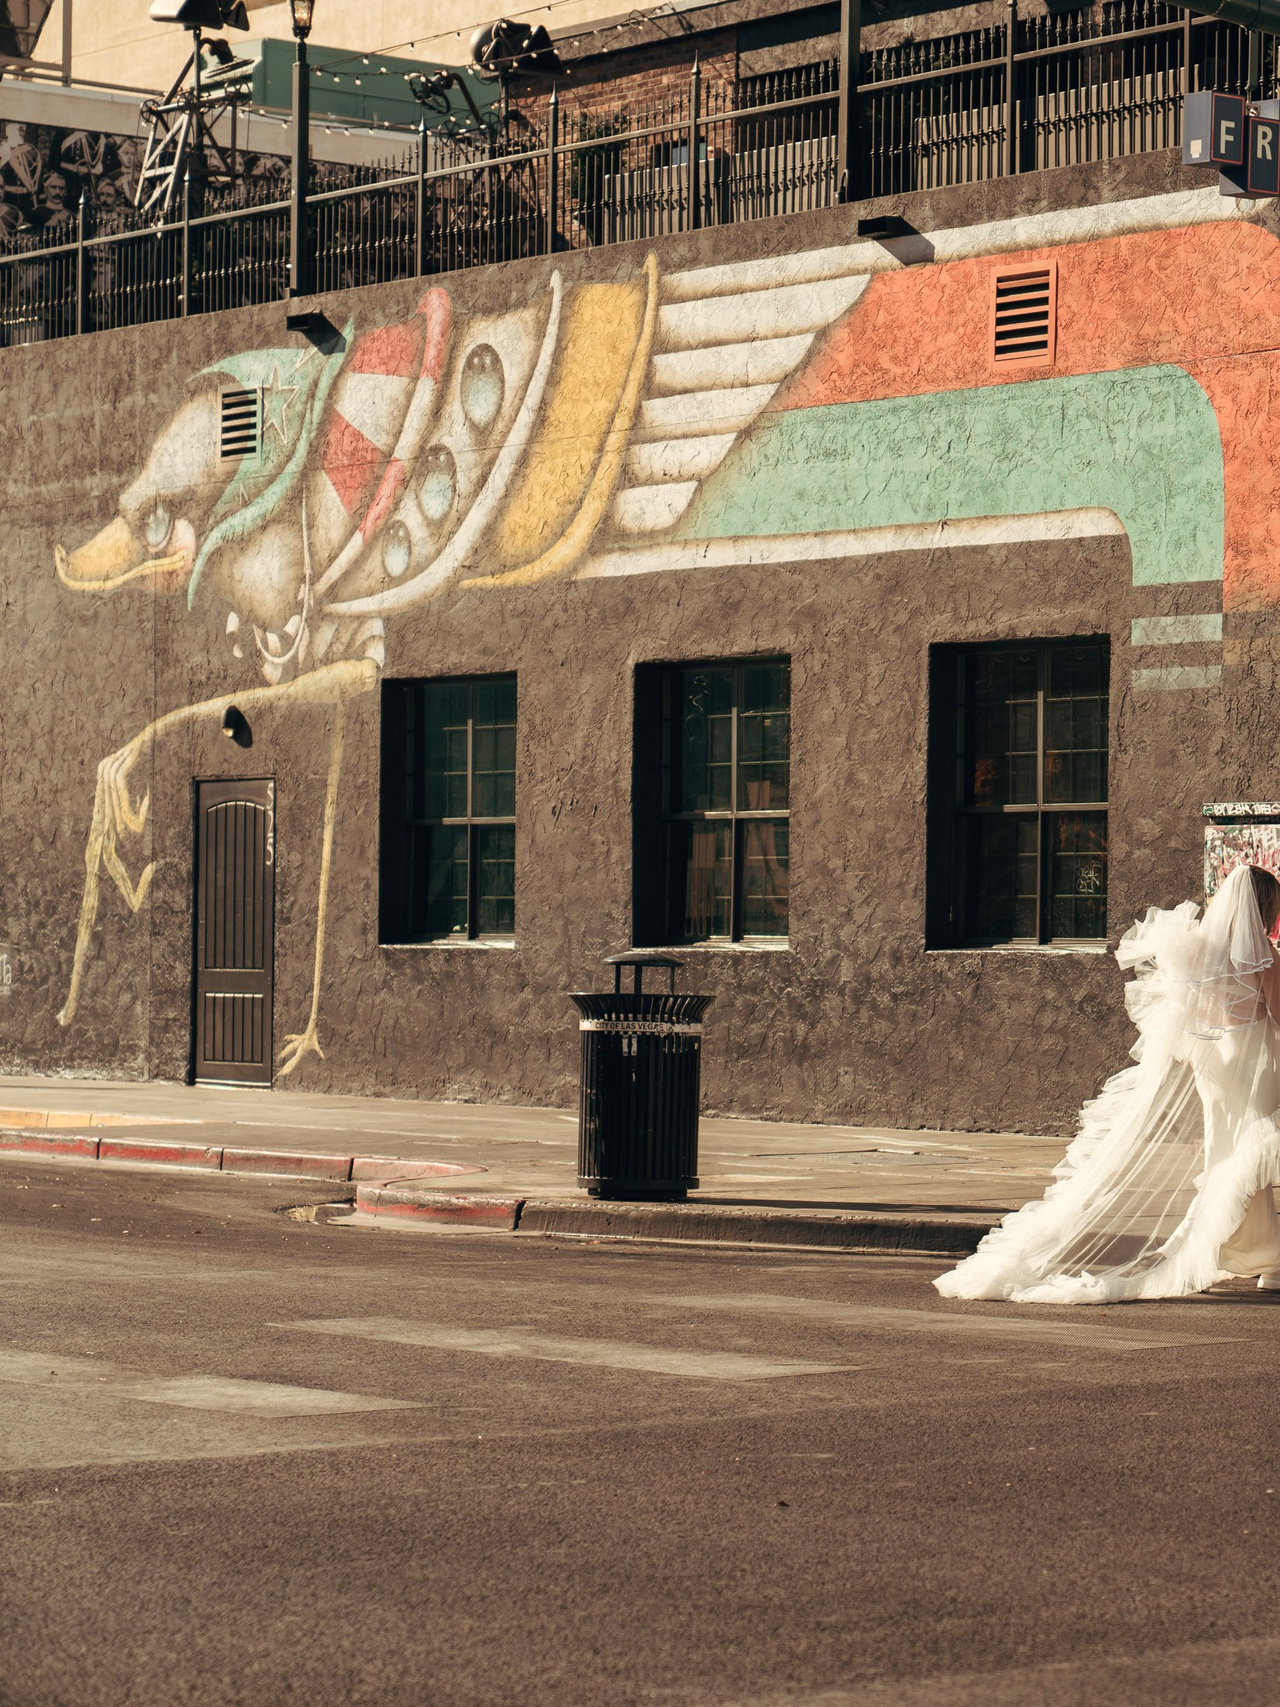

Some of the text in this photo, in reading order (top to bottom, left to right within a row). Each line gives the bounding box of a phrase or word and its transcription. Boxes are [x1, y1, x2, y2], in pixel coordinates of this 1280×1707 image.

[595, 1022, 663, 1031] CITY OF LAS VEGAS
